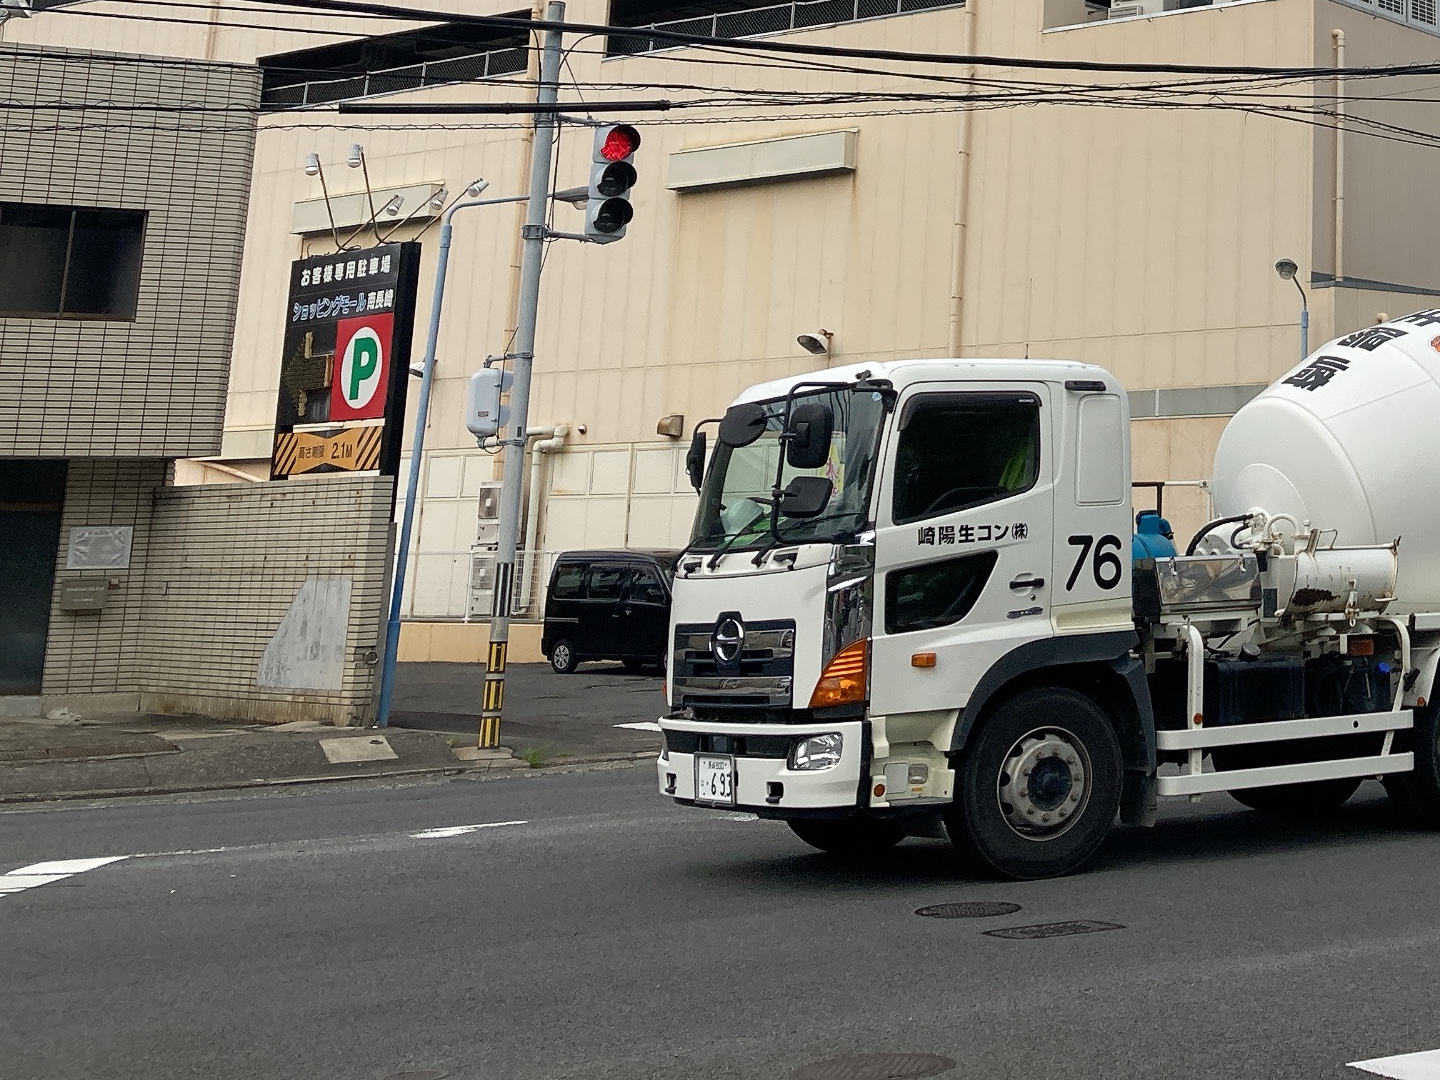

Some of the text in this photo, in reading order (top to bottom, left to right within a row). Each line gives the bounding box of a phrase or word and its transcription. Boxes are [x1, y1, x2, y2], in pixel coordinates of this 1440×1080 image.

[300, 254, 391, 287] お客様専用駐車場
[349, 336, 378, 401] P
[1066, 535, 1122, 591] 76
